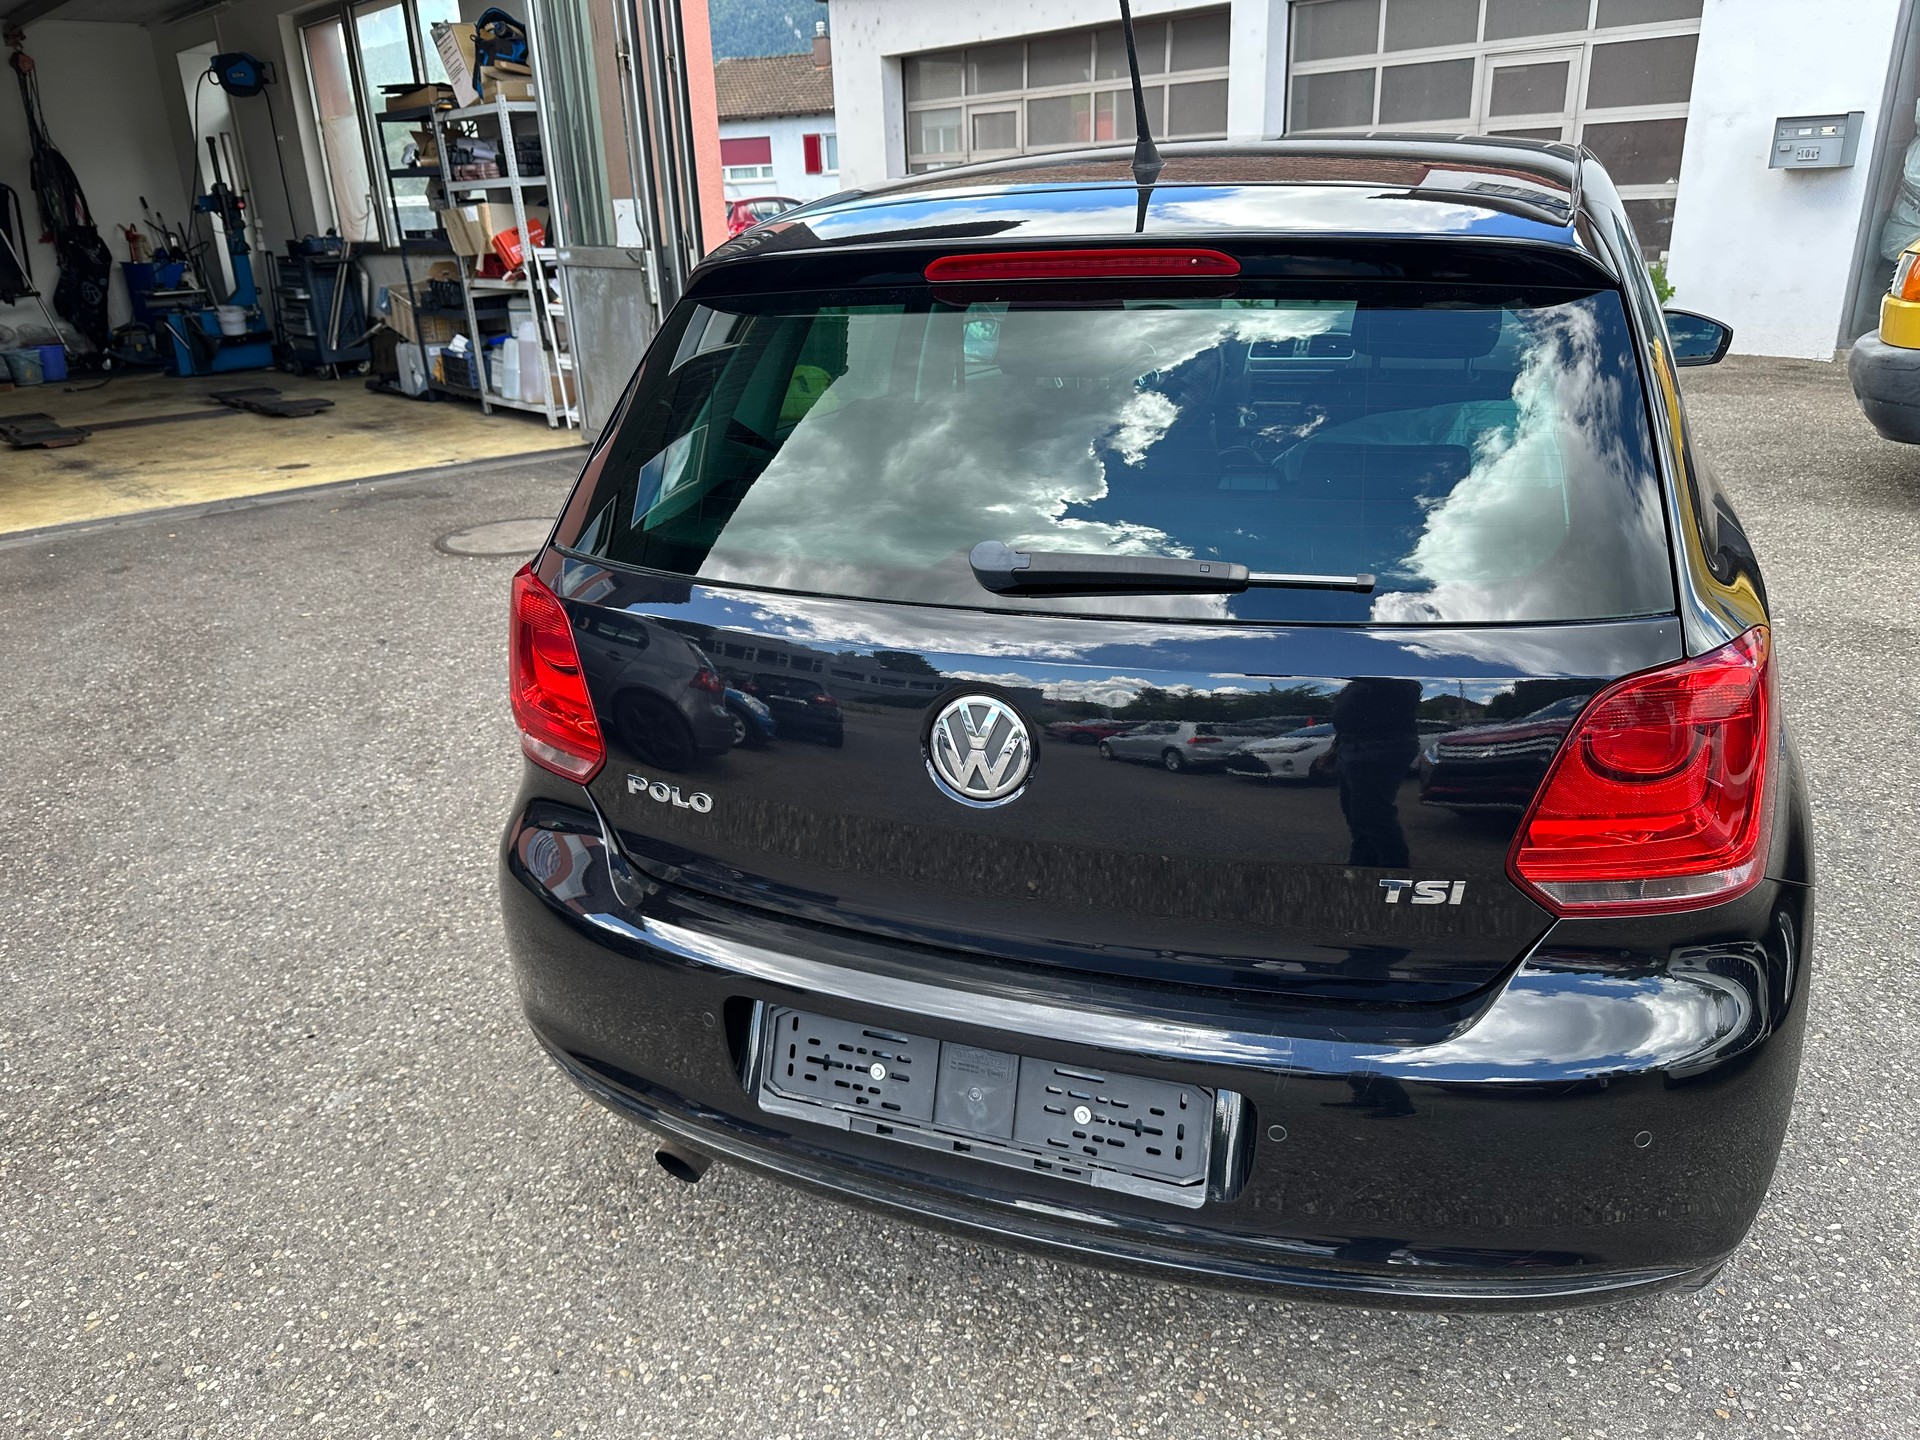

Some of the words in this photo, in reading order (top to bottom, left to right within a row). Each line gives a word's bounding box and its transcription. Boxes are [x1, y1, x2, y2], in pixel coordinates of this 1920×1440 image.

[931, 697, 1031, 799] VW
[627, 773, 714, 813] POLO
[1379, 879, 1467, 905] TSI
